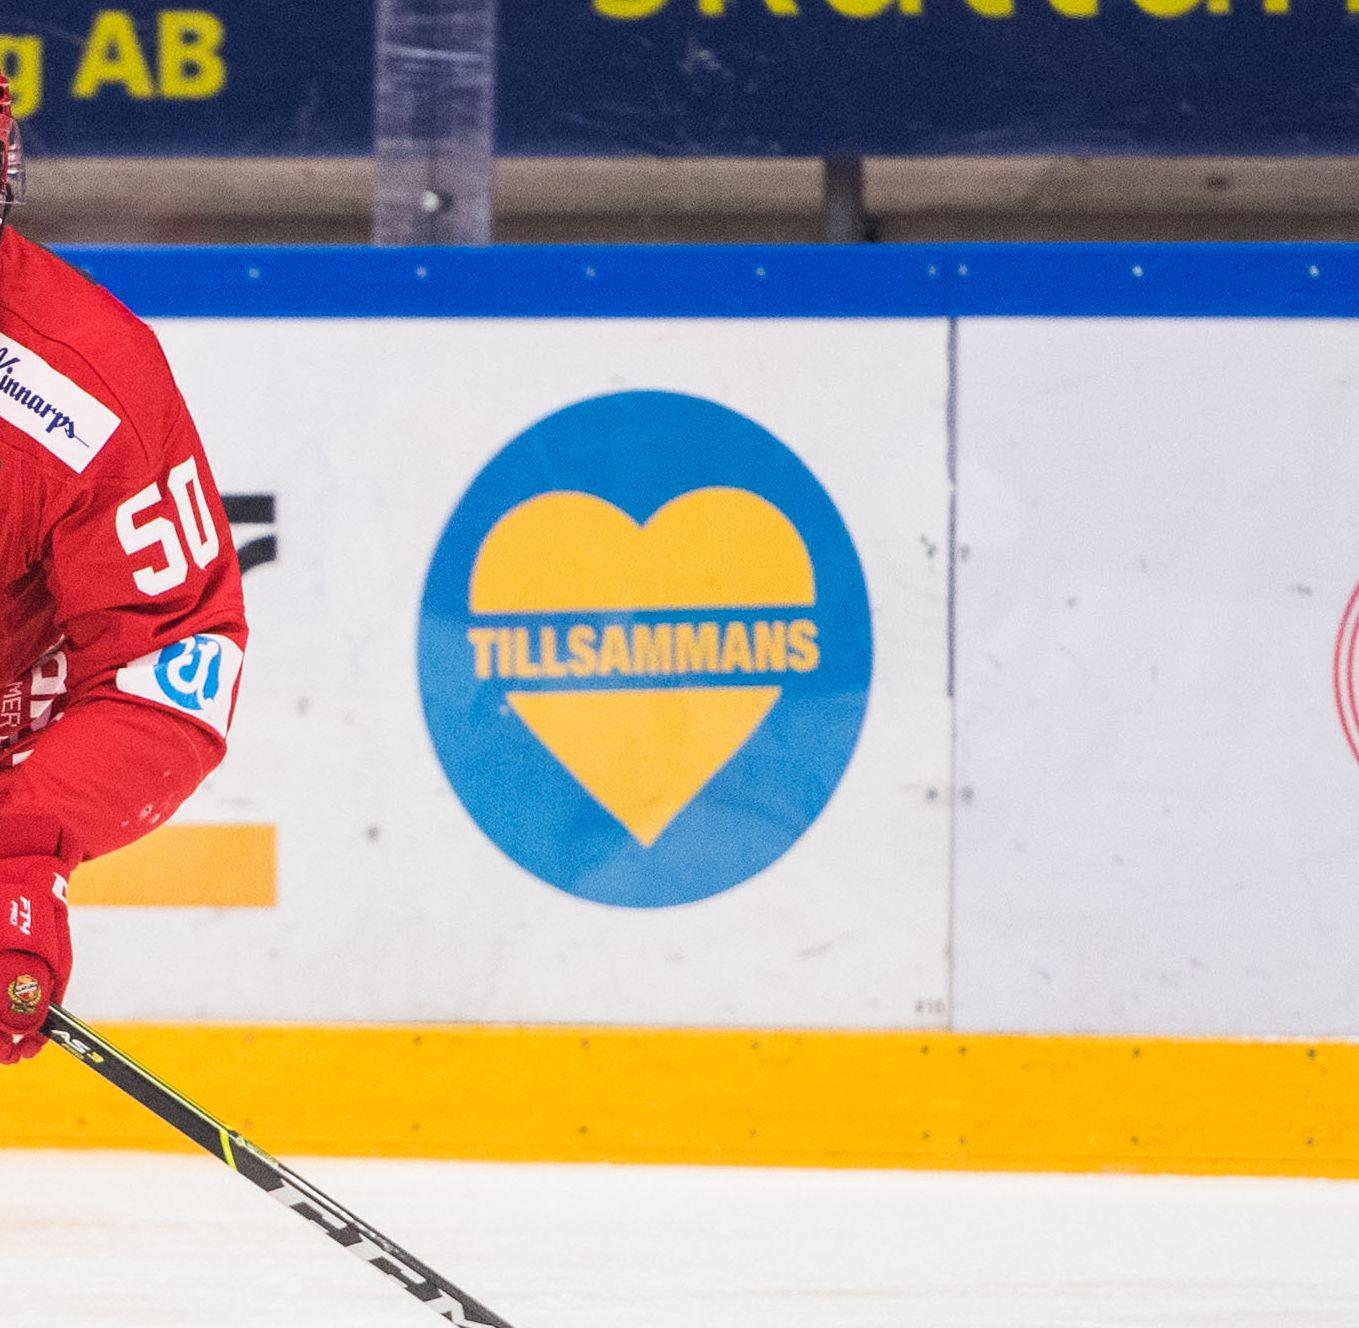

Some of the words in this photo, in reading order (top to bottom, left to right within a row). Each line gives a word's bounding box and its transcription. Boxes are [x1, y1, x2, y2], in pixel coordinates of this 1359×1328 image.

[71, 8, 227, 99] AB
[115, 455, 220, 597] 50
[466, 618, 820, 680] TILLSAMMANS
